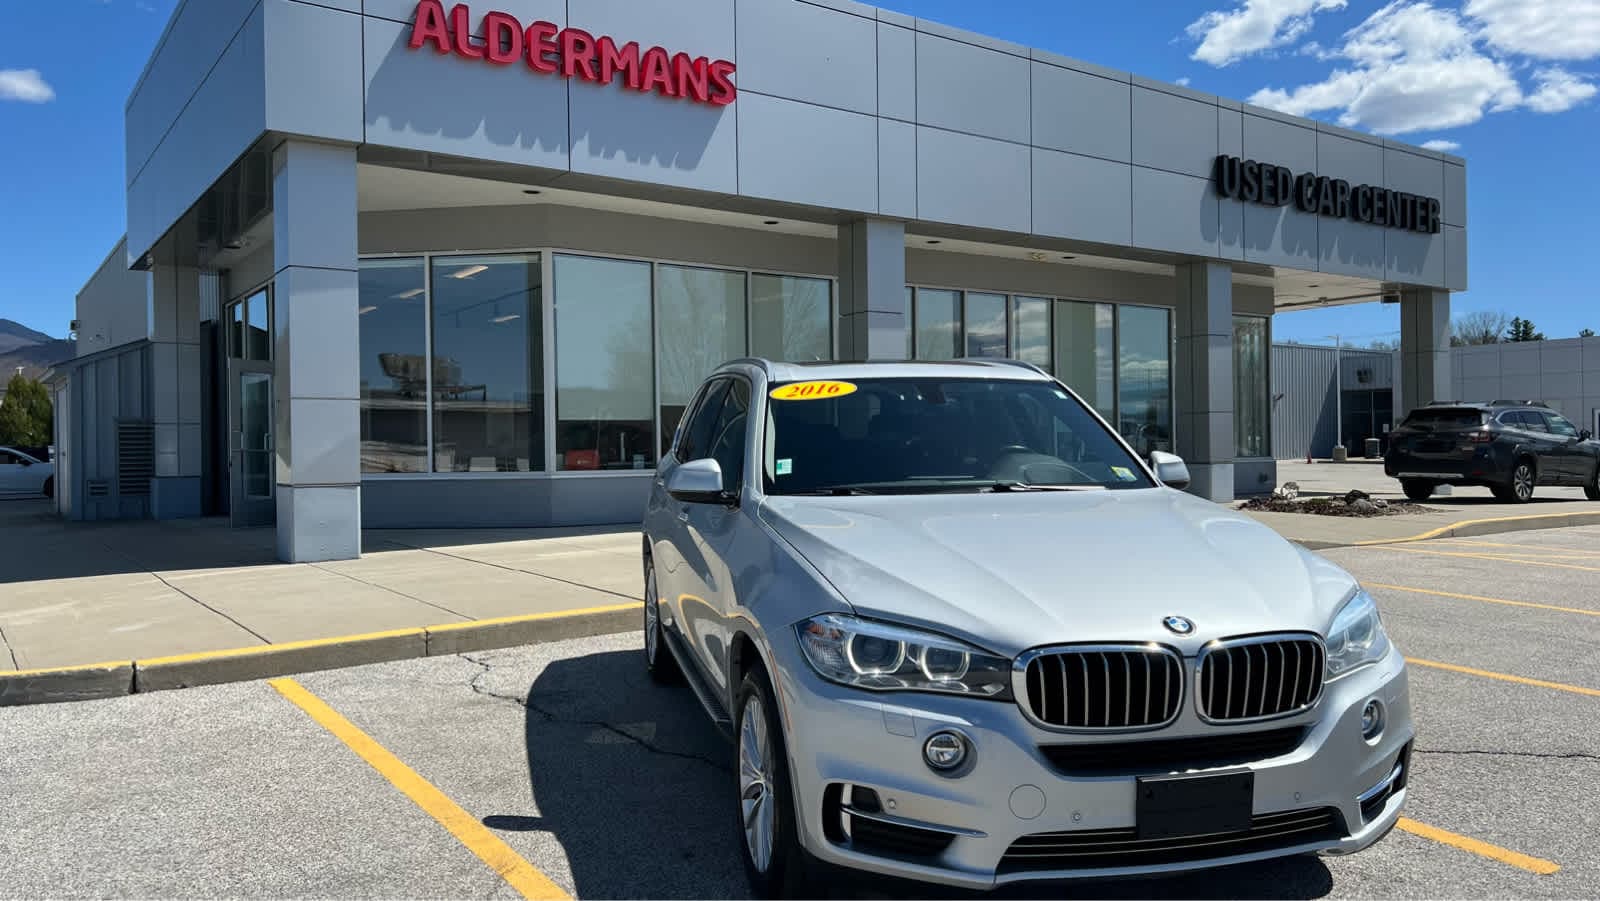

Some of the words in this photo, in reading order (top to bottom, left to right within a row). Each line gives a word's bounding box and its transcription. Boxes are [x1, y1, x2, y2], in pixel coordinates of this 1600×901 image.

[408, 0, 737, 106] ALDERMANS
[1216, 155, 1294, 207] USED
[1296, 172, 1352, 218] CAR
[1353, 183, 1440, 233] CENTER
[786, 384, 840, 397] 2016
